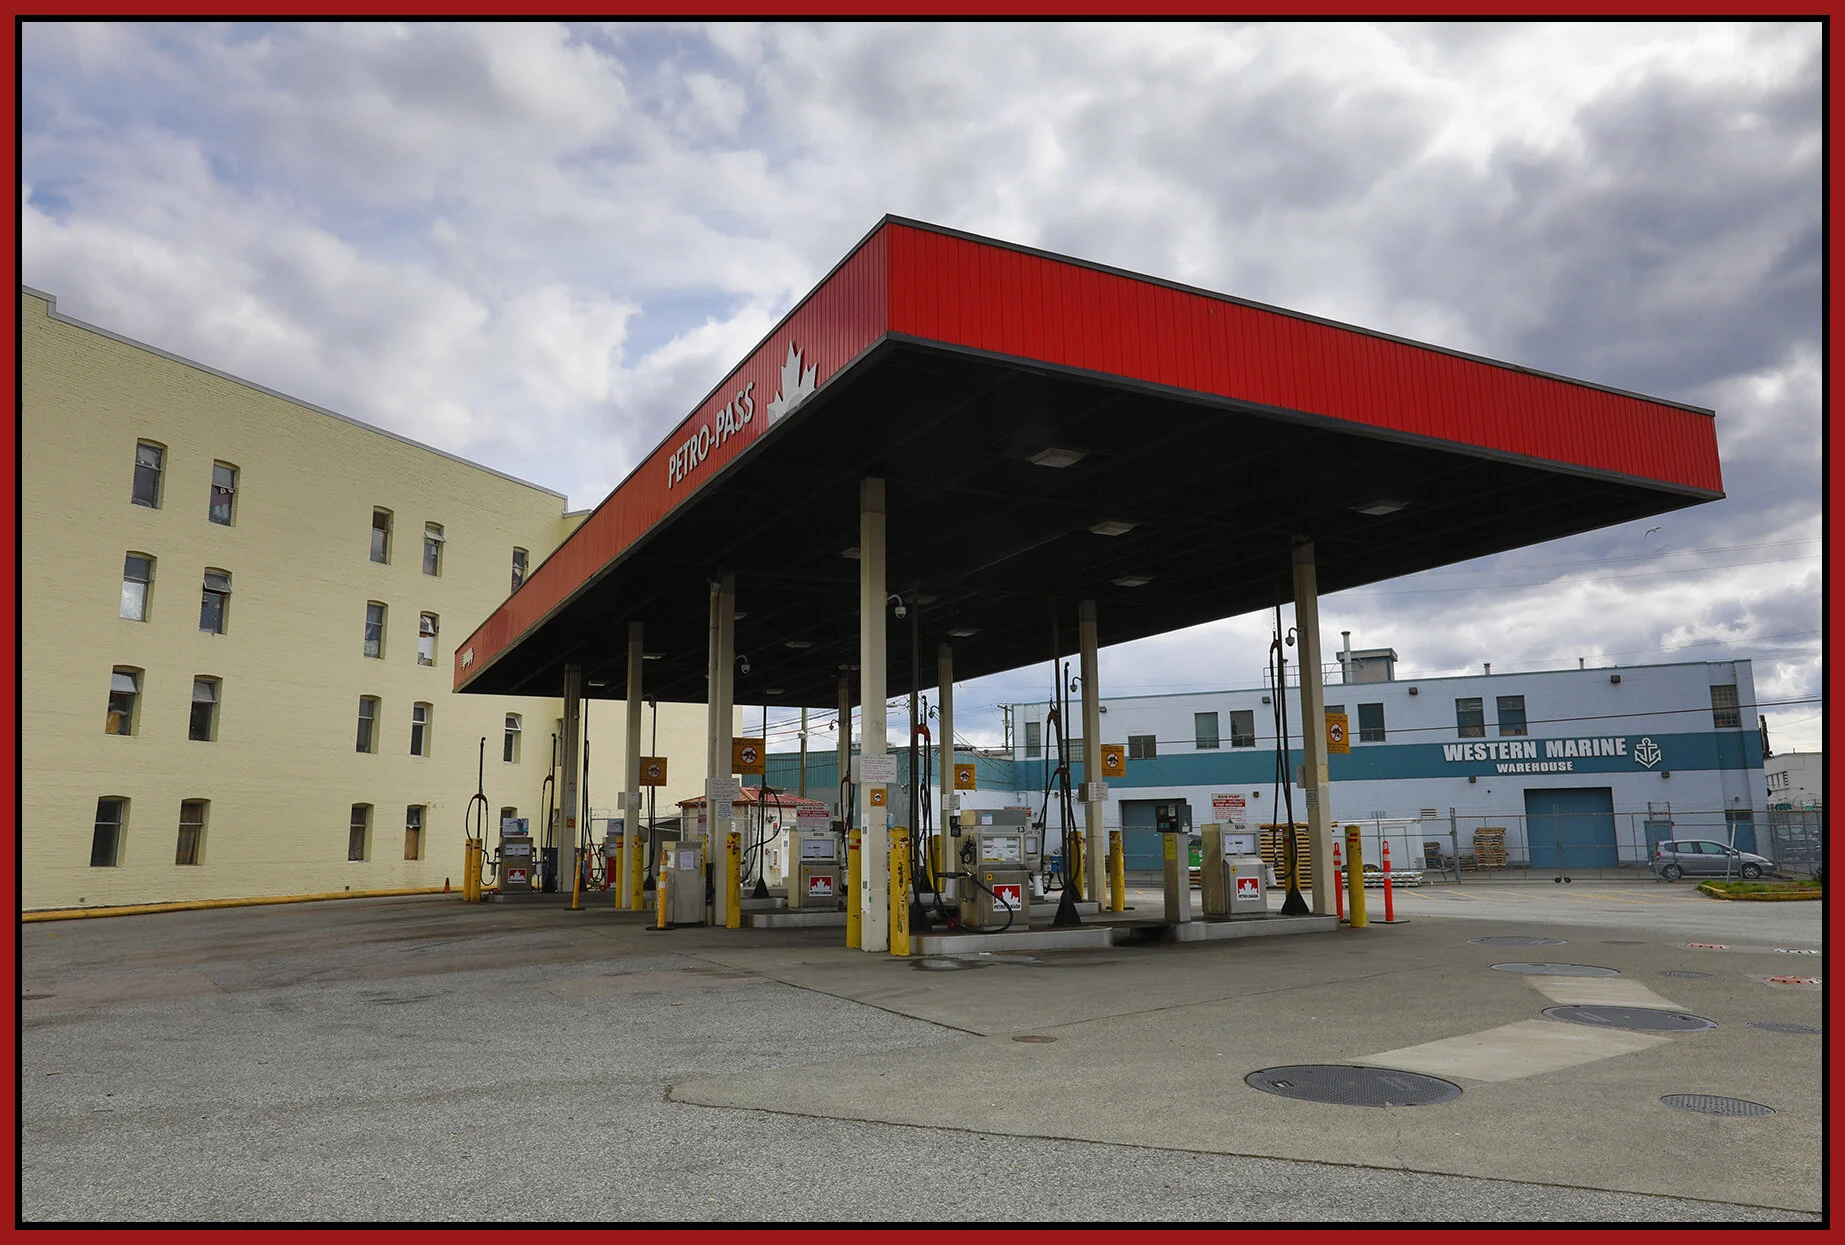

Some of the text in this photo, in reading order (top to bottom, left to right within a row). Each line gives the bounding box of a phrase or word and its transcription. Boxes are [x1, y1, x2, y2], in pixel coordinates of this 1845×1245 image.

[668, 381, 755, 490] PETRO-PASS
[1443, 737, 1628, 762] WESTERN MARINE
[1496, 761, 1574, 774] WAREHOUSE
